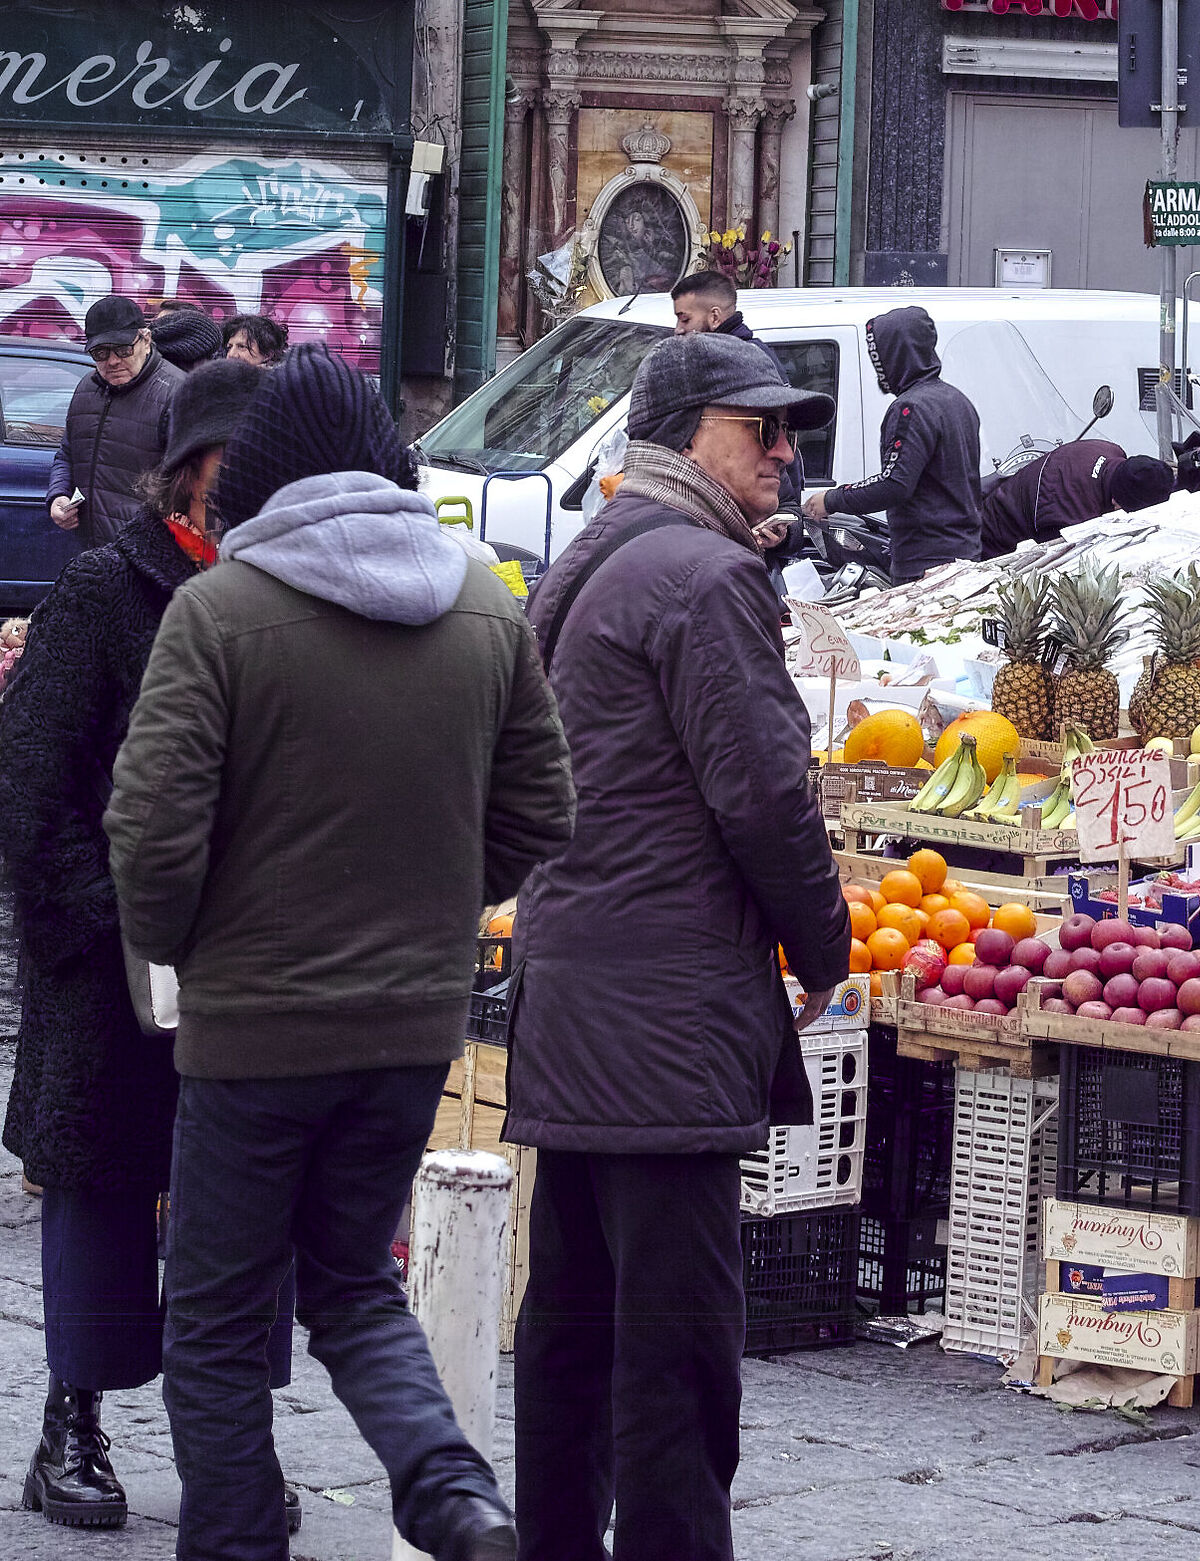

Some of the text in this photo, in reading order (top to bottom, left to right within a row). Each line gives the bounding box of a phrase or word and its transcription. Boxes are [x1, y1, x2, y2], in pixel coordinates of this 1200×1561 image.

[1163, 227, 1178, 236] dalle
[1180, 227, 1195, 236] 8:00
[801, 612, 846, 653] 2
[1074, 768, 1099, 808] 2
[1072, 1216, 1163, 1251] Vingiani
[1067, 1313, 1162, 1348] Vingiani
